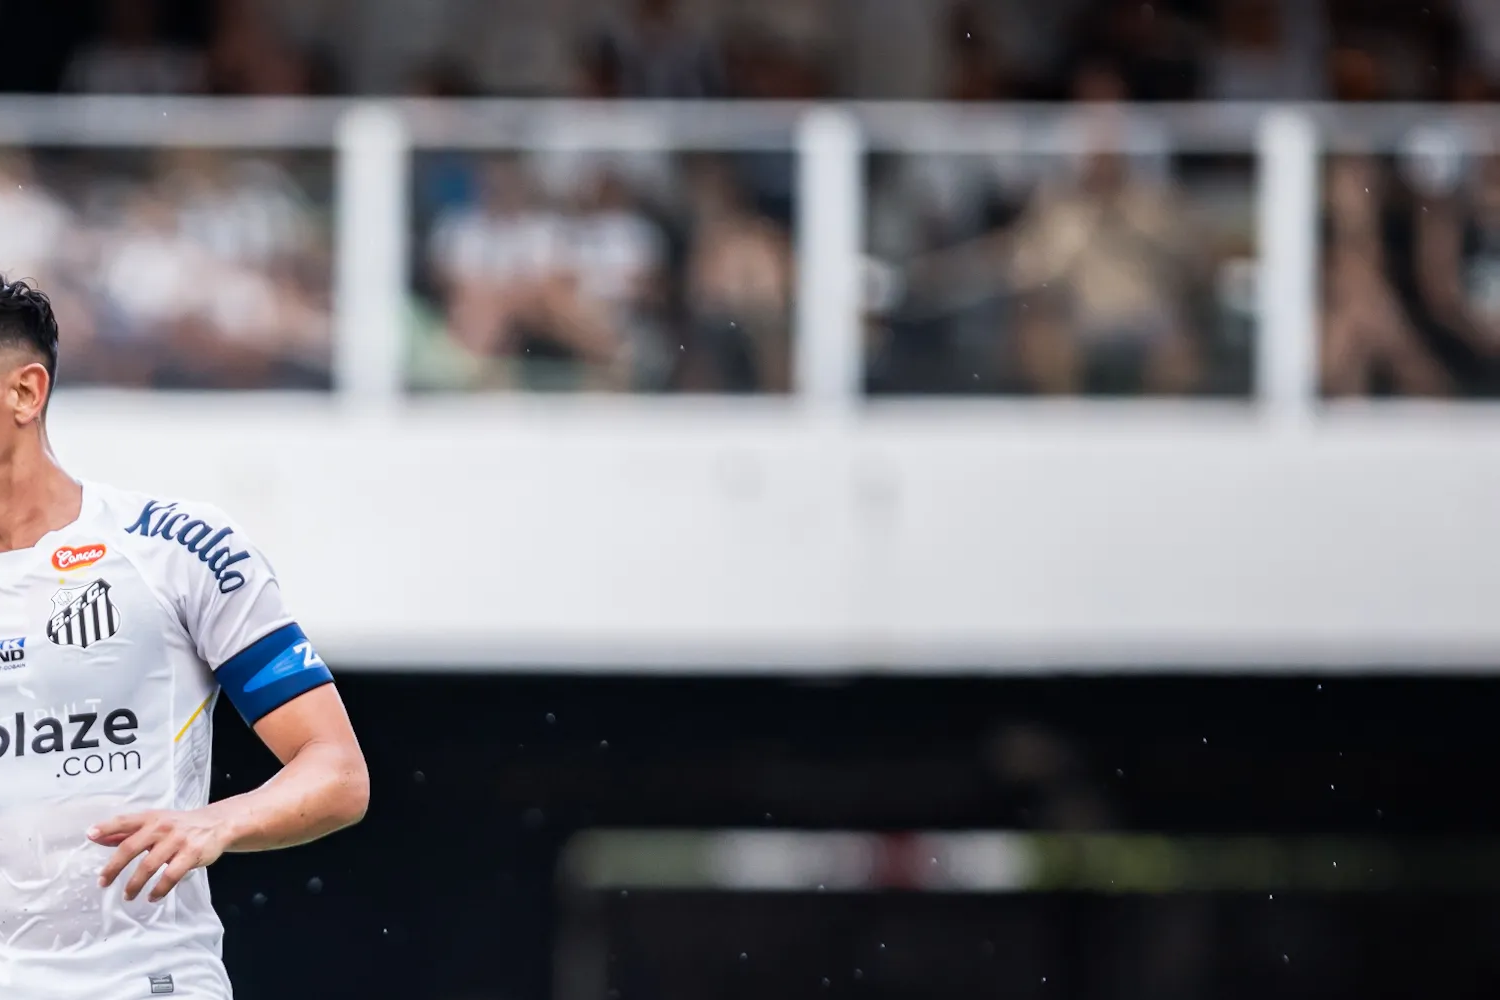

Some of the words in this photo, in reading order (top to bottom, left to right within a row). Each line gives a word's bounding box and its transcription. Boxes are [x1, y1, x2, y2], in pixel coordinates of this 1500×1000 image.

[56, 549, 104, 568] Canção
[124, 500, 251, 594] Kicaldo
[56, 750, 141, 778] .com
